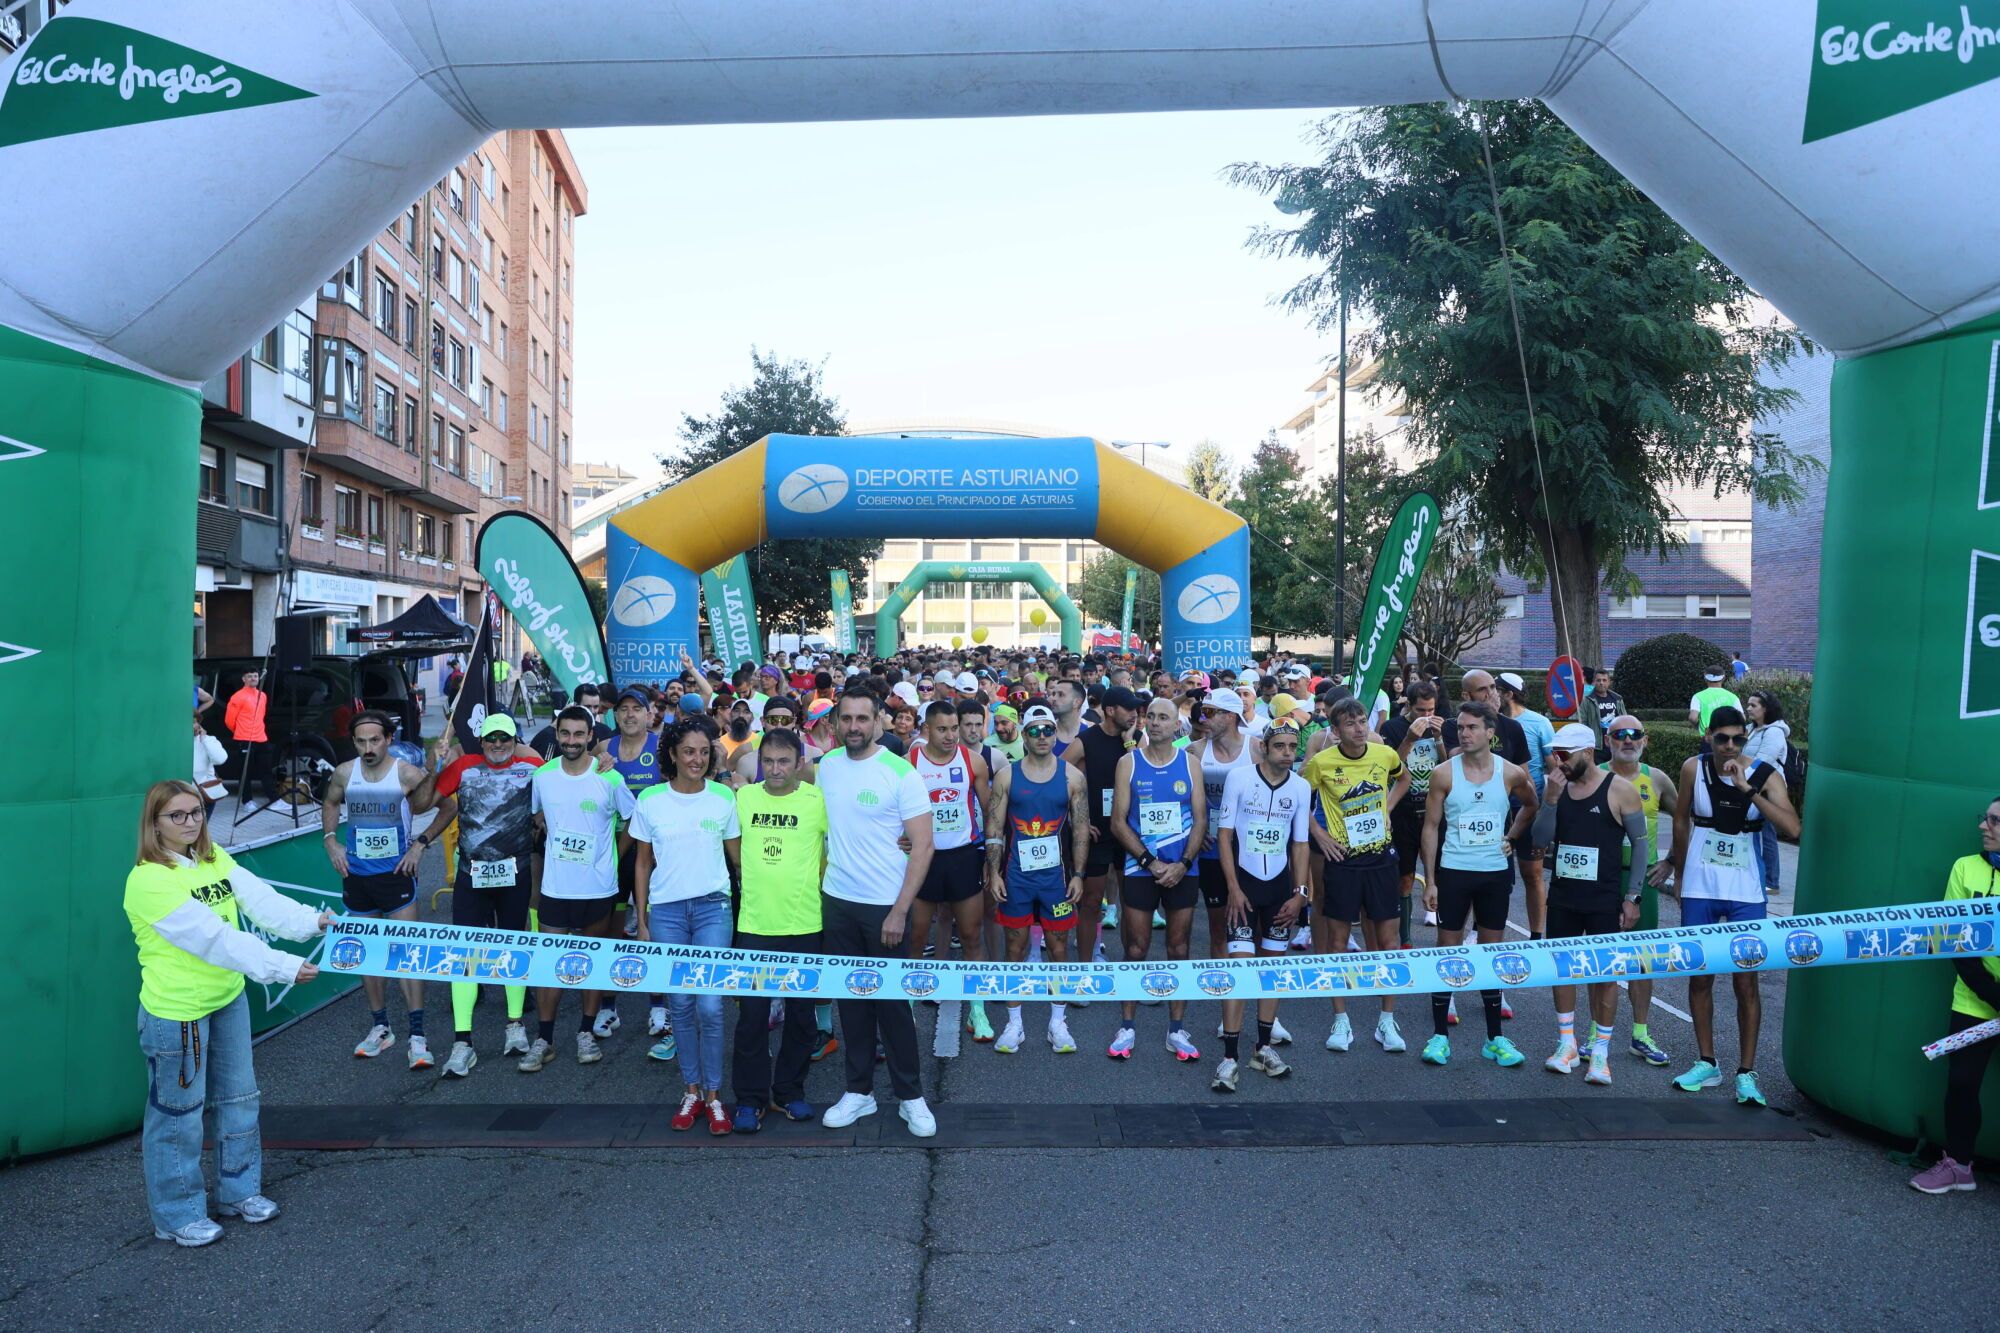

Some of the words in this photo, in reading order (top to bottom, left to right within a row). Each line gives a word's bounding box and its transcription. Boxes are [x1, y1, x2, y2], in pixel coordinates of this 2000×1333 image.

[1820, 25, 1860, 66] El
[1862, 21, 1953, 60] Corte
[1957, 5, 2000, 64] In
[16, 57, 42, 86] El
[44, 53, 116, 85] Corte
[119, 45, 242, 104] Inglés
[855, 468, 954, 487] DEPORTE
[959, 467, 1080, 486] ASTURIANO
[857, 494, 913, 506] GOBIERNO
[915, 494, 935, 506] DEL
[936, 493, 1000, 506] PRINCIPADO
[1002, 494, 1017, 506] DE
[1020, 493, 1075, 505] ASTURIAS
[1358, 604, 1391, 672] Corte
[608, 642, 688, 657] DEPORTE
[1174, 639, 1249, 654] DEPORTE
[1412, 744, 1432, 756] 134
[936, 808, 959, 821] 514
[1148, 810, 1173, 822] 387
[1354, 818, 1378, 833] 259
[1468, 820, 1493, 833] 450
[364, 835, 389, 847] 356
[1255, 829, 1280, 842] 548
[561, 836, 587, 851] 412
[1031, 844, 1048, 857] 60
[1716, 840, 1735, 854] 81
[763, 845, 782, 857] MOM
[1563, 852, 1589, 866] 565
[481, 863, 506, 875] 218
[1773, 916, 1827, 930] MEDIA
[1830, 907, 1912, 925] MARATÓN
[1914, 902, 1968, 919] VERDE
[1971, 902, 1994, 915] DE
[331, 921, 379, 936] MEDIA
[383, 926, 461, 942] MARATÓN
[464, 931, 513, 945] VERDE
[516, 936, 538, 947] DE
[541, 937, 602, 951] OVIEDO
[1483, 941, 1534, 953] MEDIA
[1537, 934, 1617, 950] MARATÓN
[1620, 930, 1671, 941] VERDE
[1674, 926, 1698, 938] DE
[1701, 921, 1762, 936] OVIEDO
[613, 943, 663, 956] MEDIA
[667, 949, 745, 962] MARATÓN
[749, 953, 799, 965] VERDE
[803, 956, 825, 966] DE
[828, 958, 889, 969] OVIEDO
[1192, 959, 1242, 970] MEDIA
[1246, 955, 1326, 968] MARATÓN
[1329, 954, 1379, 964] VERDE
[1384, 951, 1407, 960] DE
[1409, 946, 1470, 957] OVIEDO
[901, 961, 951, 970] MEDIA
[955, 962, 1034, 972] MARATÓN
[1038, 963, 1089, 972] VERDE
[1092, 963, 1115, 972] DE
[1118, 962, 1179, 972] OVIEDO
